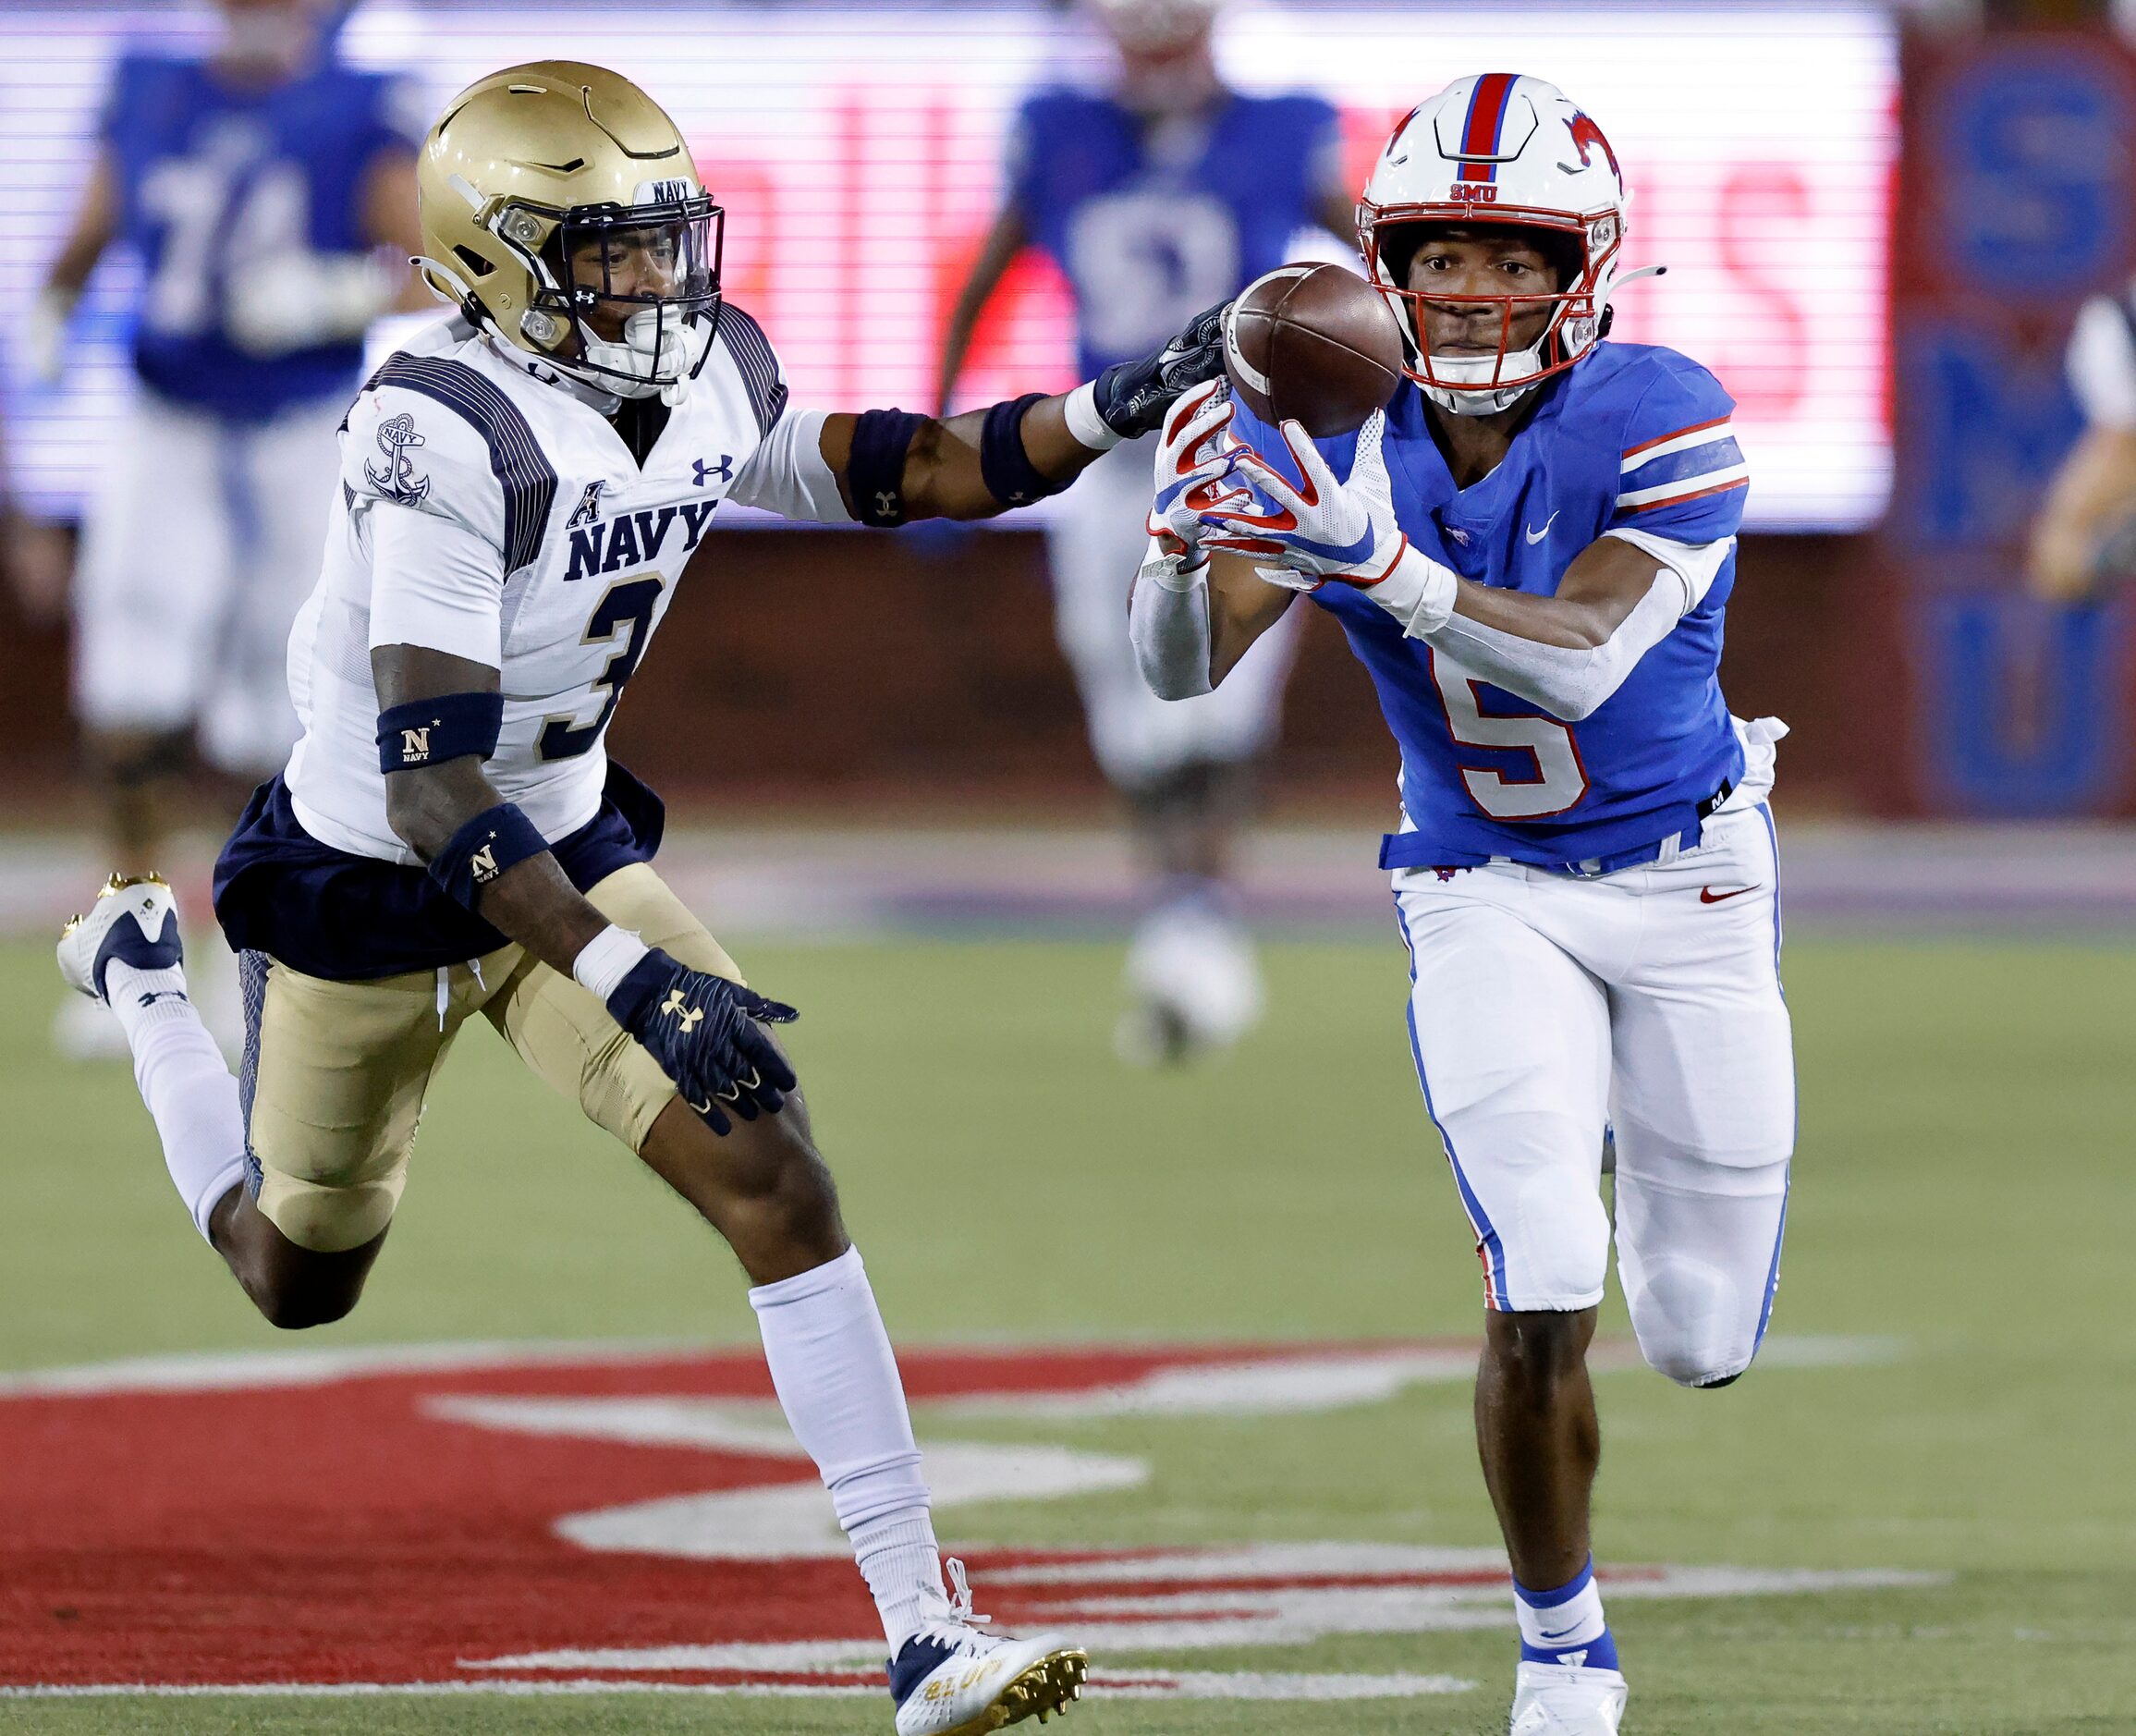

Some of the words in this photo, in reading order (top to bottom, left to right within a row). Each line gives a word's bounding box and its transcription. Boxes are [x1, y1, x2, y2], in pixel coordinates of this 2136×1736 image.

[652, 179, 688, 203] NAVY
[1449, 184, 1498, 202] SMU
[384, 428, 416, 444] NAVY
[563, 499, 718, 581] NAVY
[532, 569, 665, 764] 3
[401, 727, 430, 753] N
[1427, 645, 1592, 822] 5
[403, 752, 429, 763] NAVY
[470, 844, 496, 877] N
